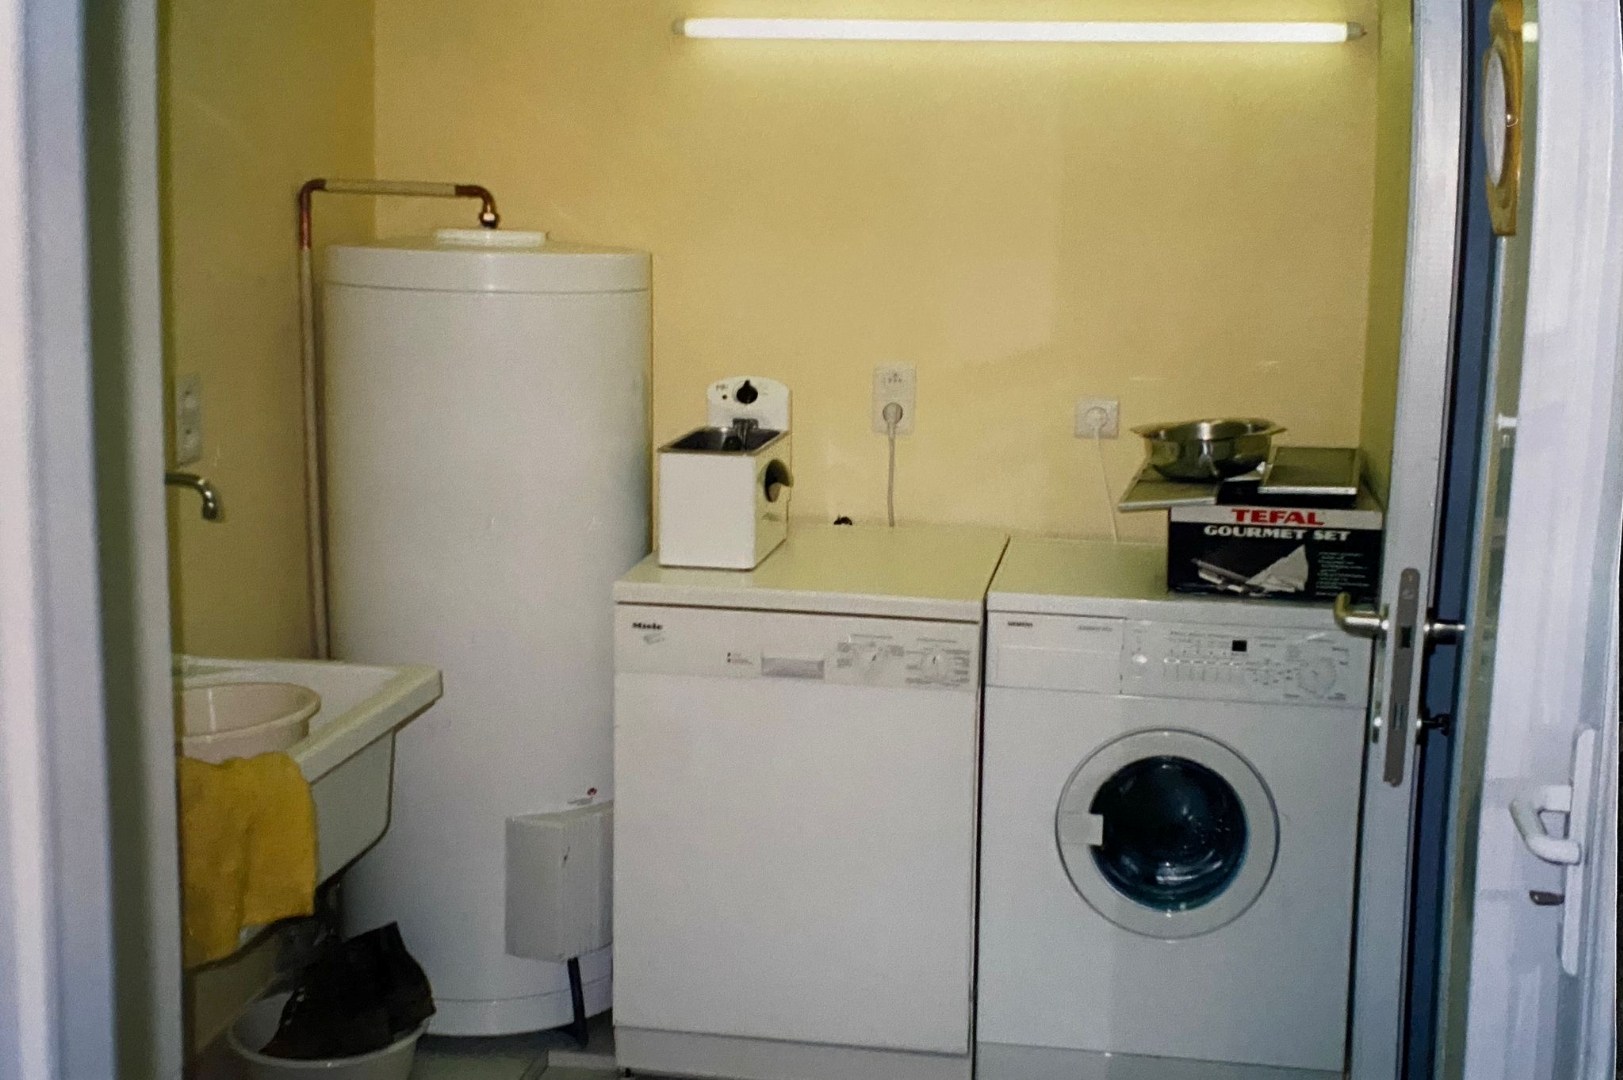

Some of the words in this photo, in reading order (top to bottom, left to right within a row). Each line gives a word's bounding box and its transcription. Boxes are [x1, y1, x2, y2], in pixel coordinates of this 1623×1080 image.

[1231, 508, 1325, 526] TEFAL
[1203, 524, 1307, 540] GOURMET
[1312, 529, 1351, 541] SET
[632, 622, 663, 630] Miele
